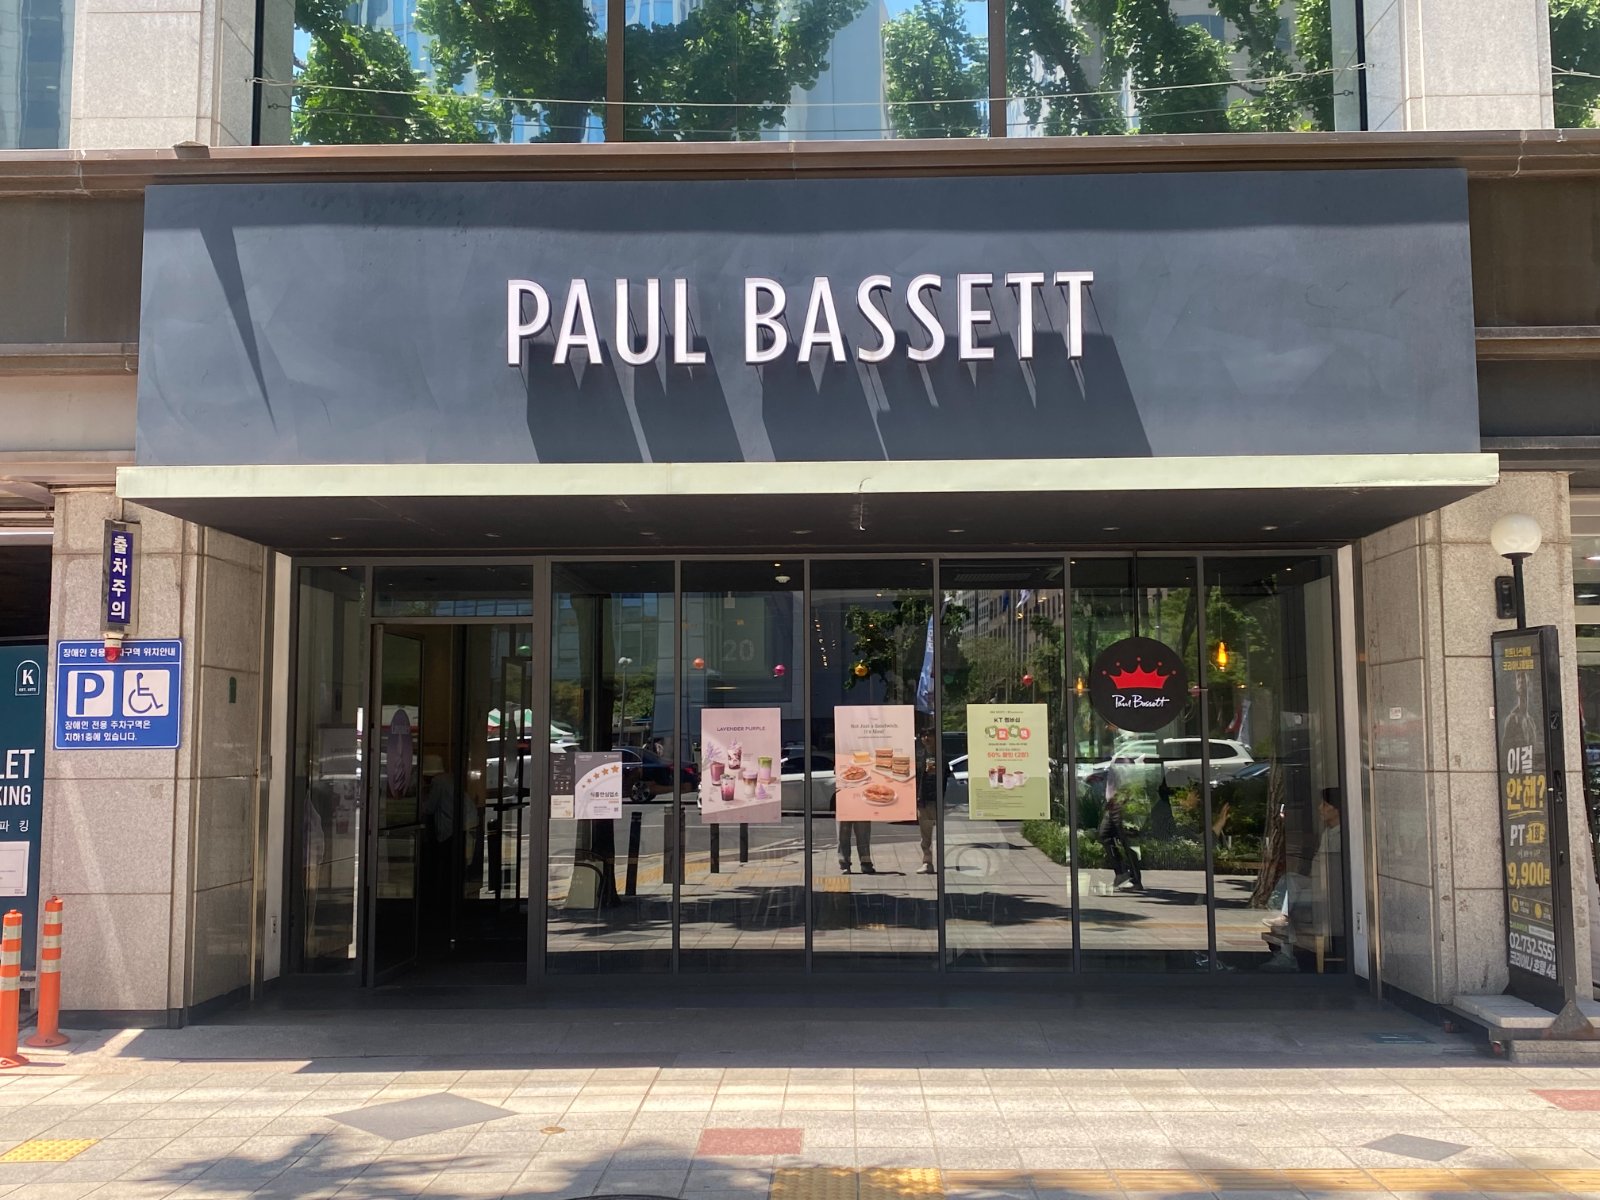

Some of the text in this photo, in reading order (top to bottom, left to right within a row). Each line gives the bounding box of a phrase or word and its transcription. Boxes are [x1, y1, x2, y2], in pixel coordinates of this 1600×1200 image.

[507, 270, 1095, 366] PAUL BASSETT
[110, 536, 128, 619] 출차주의
[62, 648, 87, 658] 장애인
[143, 647, 176, 657] 위치안내
[22, 669, 35, 685] K
[75, 672, 105, 715] P
[1111, 694, 1132, 709] Paul
[64, 719, 151, 731] 장애인 전용 주차구역은
[64, 731, 138, 742] 지하1층에 있습니다.
[1507, 745, 1533, 775] 이걸
[1506, 774, 1546, 811] 안해?
[1510, 824, 1526, 847] PT
[1508, 861, 1551, 889] 9,900원
[1509, 950, 1534, 972] 코리아나
[1532, 958, 1547, 977] 호텔
